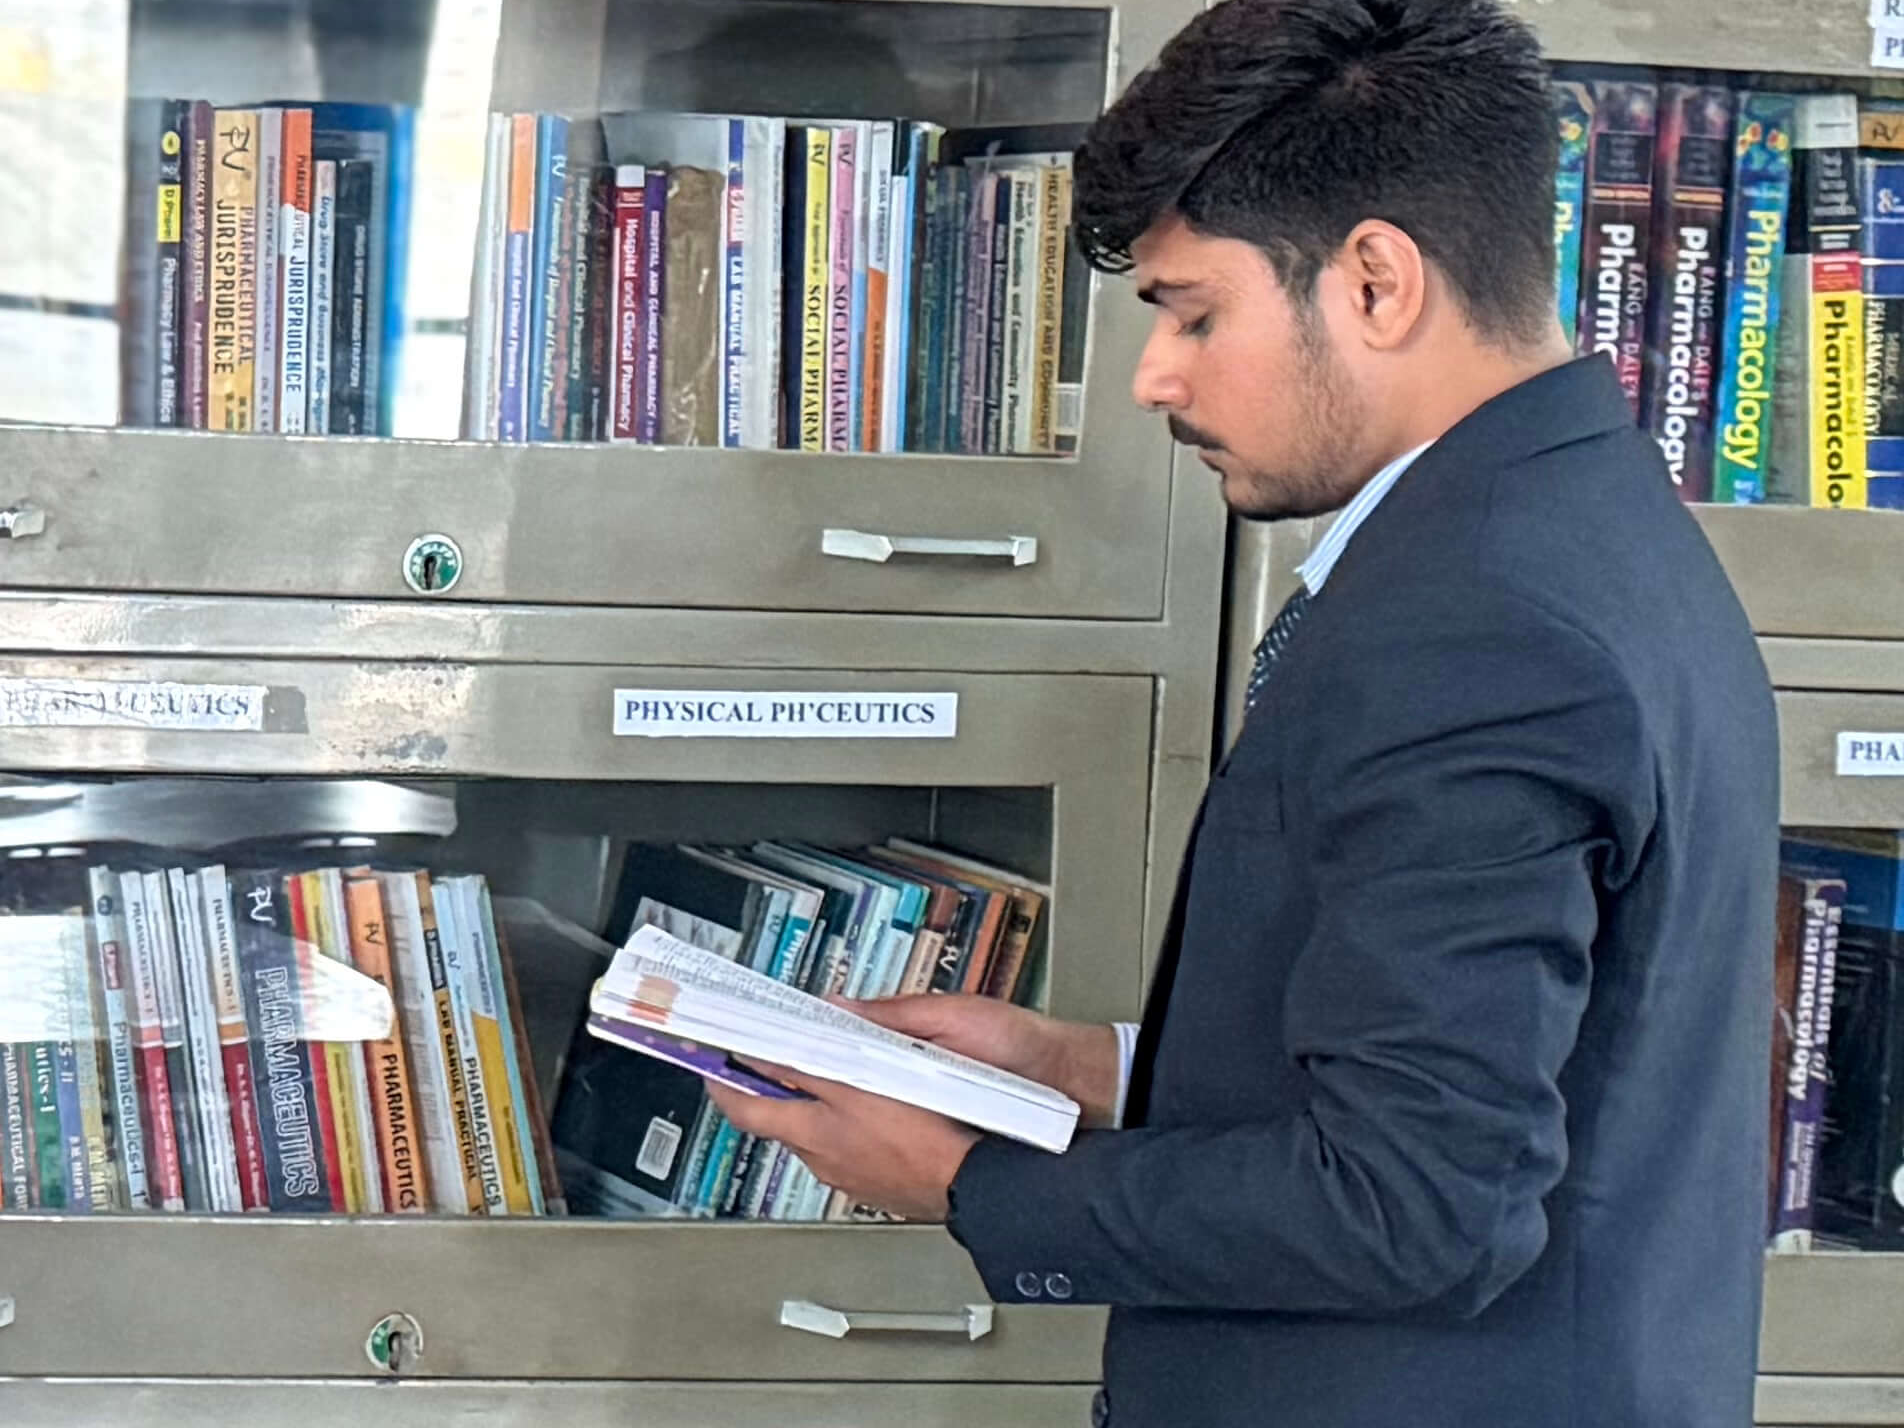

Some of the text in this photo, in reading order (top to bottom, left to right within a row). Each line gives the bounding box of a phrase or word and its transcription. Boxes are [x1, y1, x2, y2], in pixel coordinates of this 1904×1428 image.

[161, 257, 177, 361] Pharmacy Law
[213, 199, 236, 376] JURISPRUDENCE
[237, 205, 256, 366] PHARMACEUTICAL
[286, 255, 308, 394] JURISPRUDENCE
[621, 218, 639, 362] Hospital Clinical
[807, 283, 822, 365] SOCIAL
[833, 283, 850, 365] SOCIAL
[1721, 208, 1781, 471] Pharmacology
[626, 700, 936, 724] PHYSICAL PH'CEUTICS
[1788, 897, 1827, 1102] Pharmacology
[1811, 904, 1842, 1082] Essentials of
[255, 967, 320, 1198] PHARMACEUTICS
[382, 1053, 418, 1211] PHARMACEUTICS
[465, 1056, 504, 1207] PHARMACEUTICS
